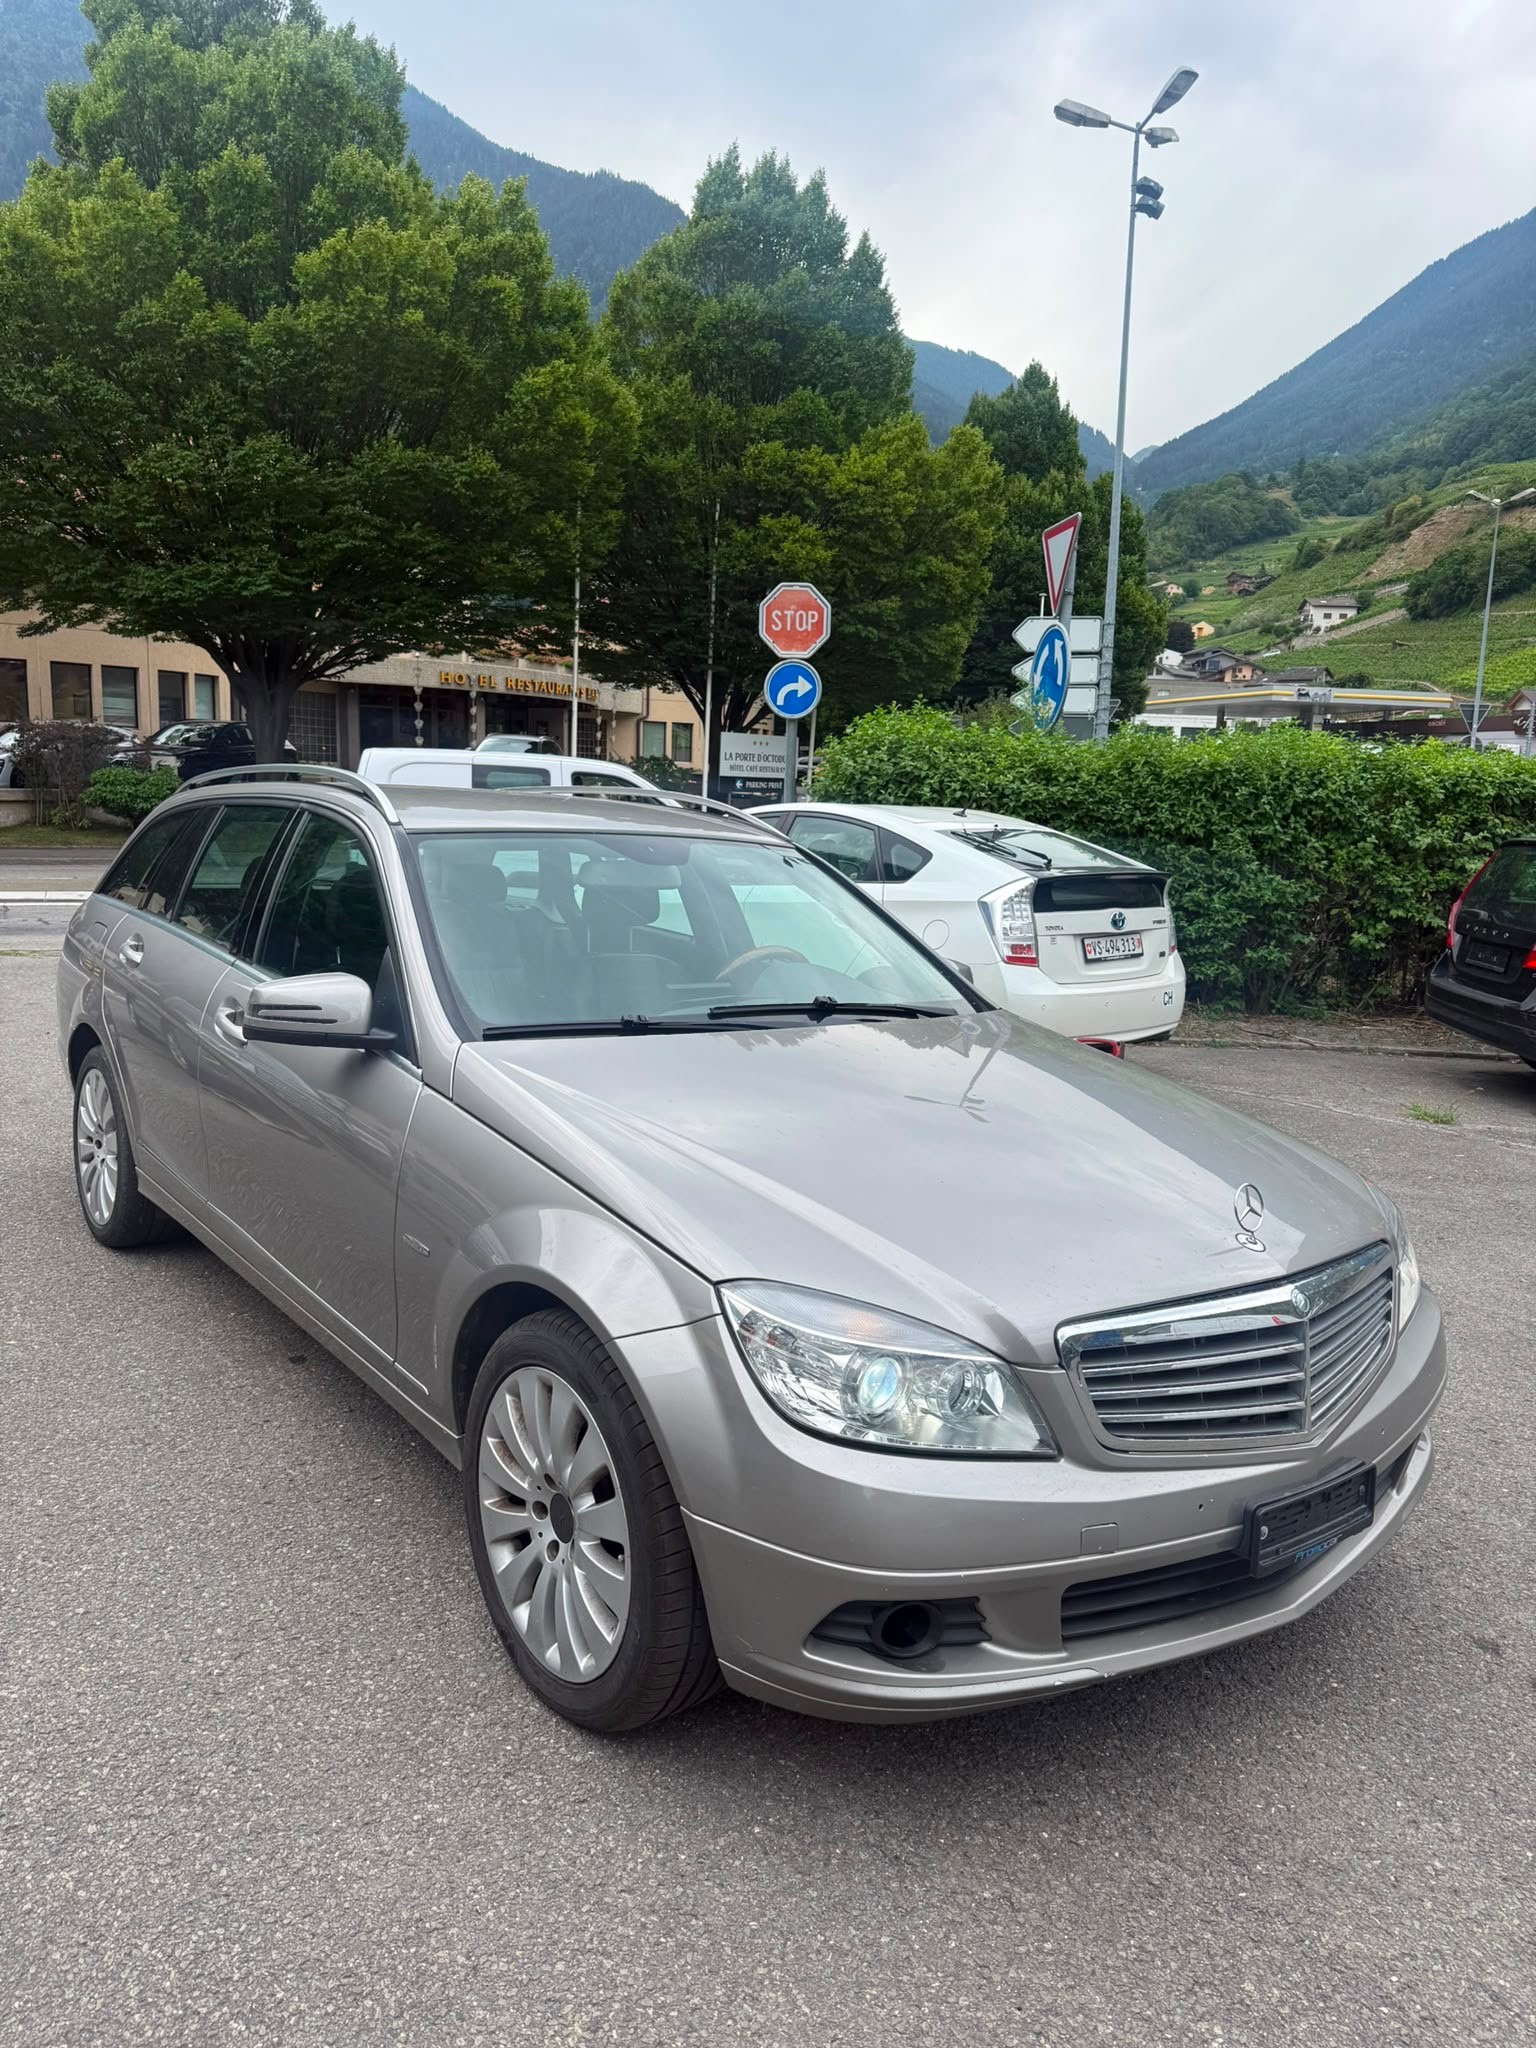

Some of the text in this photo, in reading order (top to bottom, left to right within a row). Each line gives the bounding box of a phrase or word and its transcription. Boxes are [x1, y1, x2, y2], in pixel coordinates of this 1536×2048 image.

[771, 609, 818, 631] STOP
[724, 752, 733, 761] LA
[735, 752, 756, 762] PORTE
[759, 765, 785, 773] RESTAURA
[745, 781, 767, 789] PARKING
[1163, 991, 1173, 1005] CH
